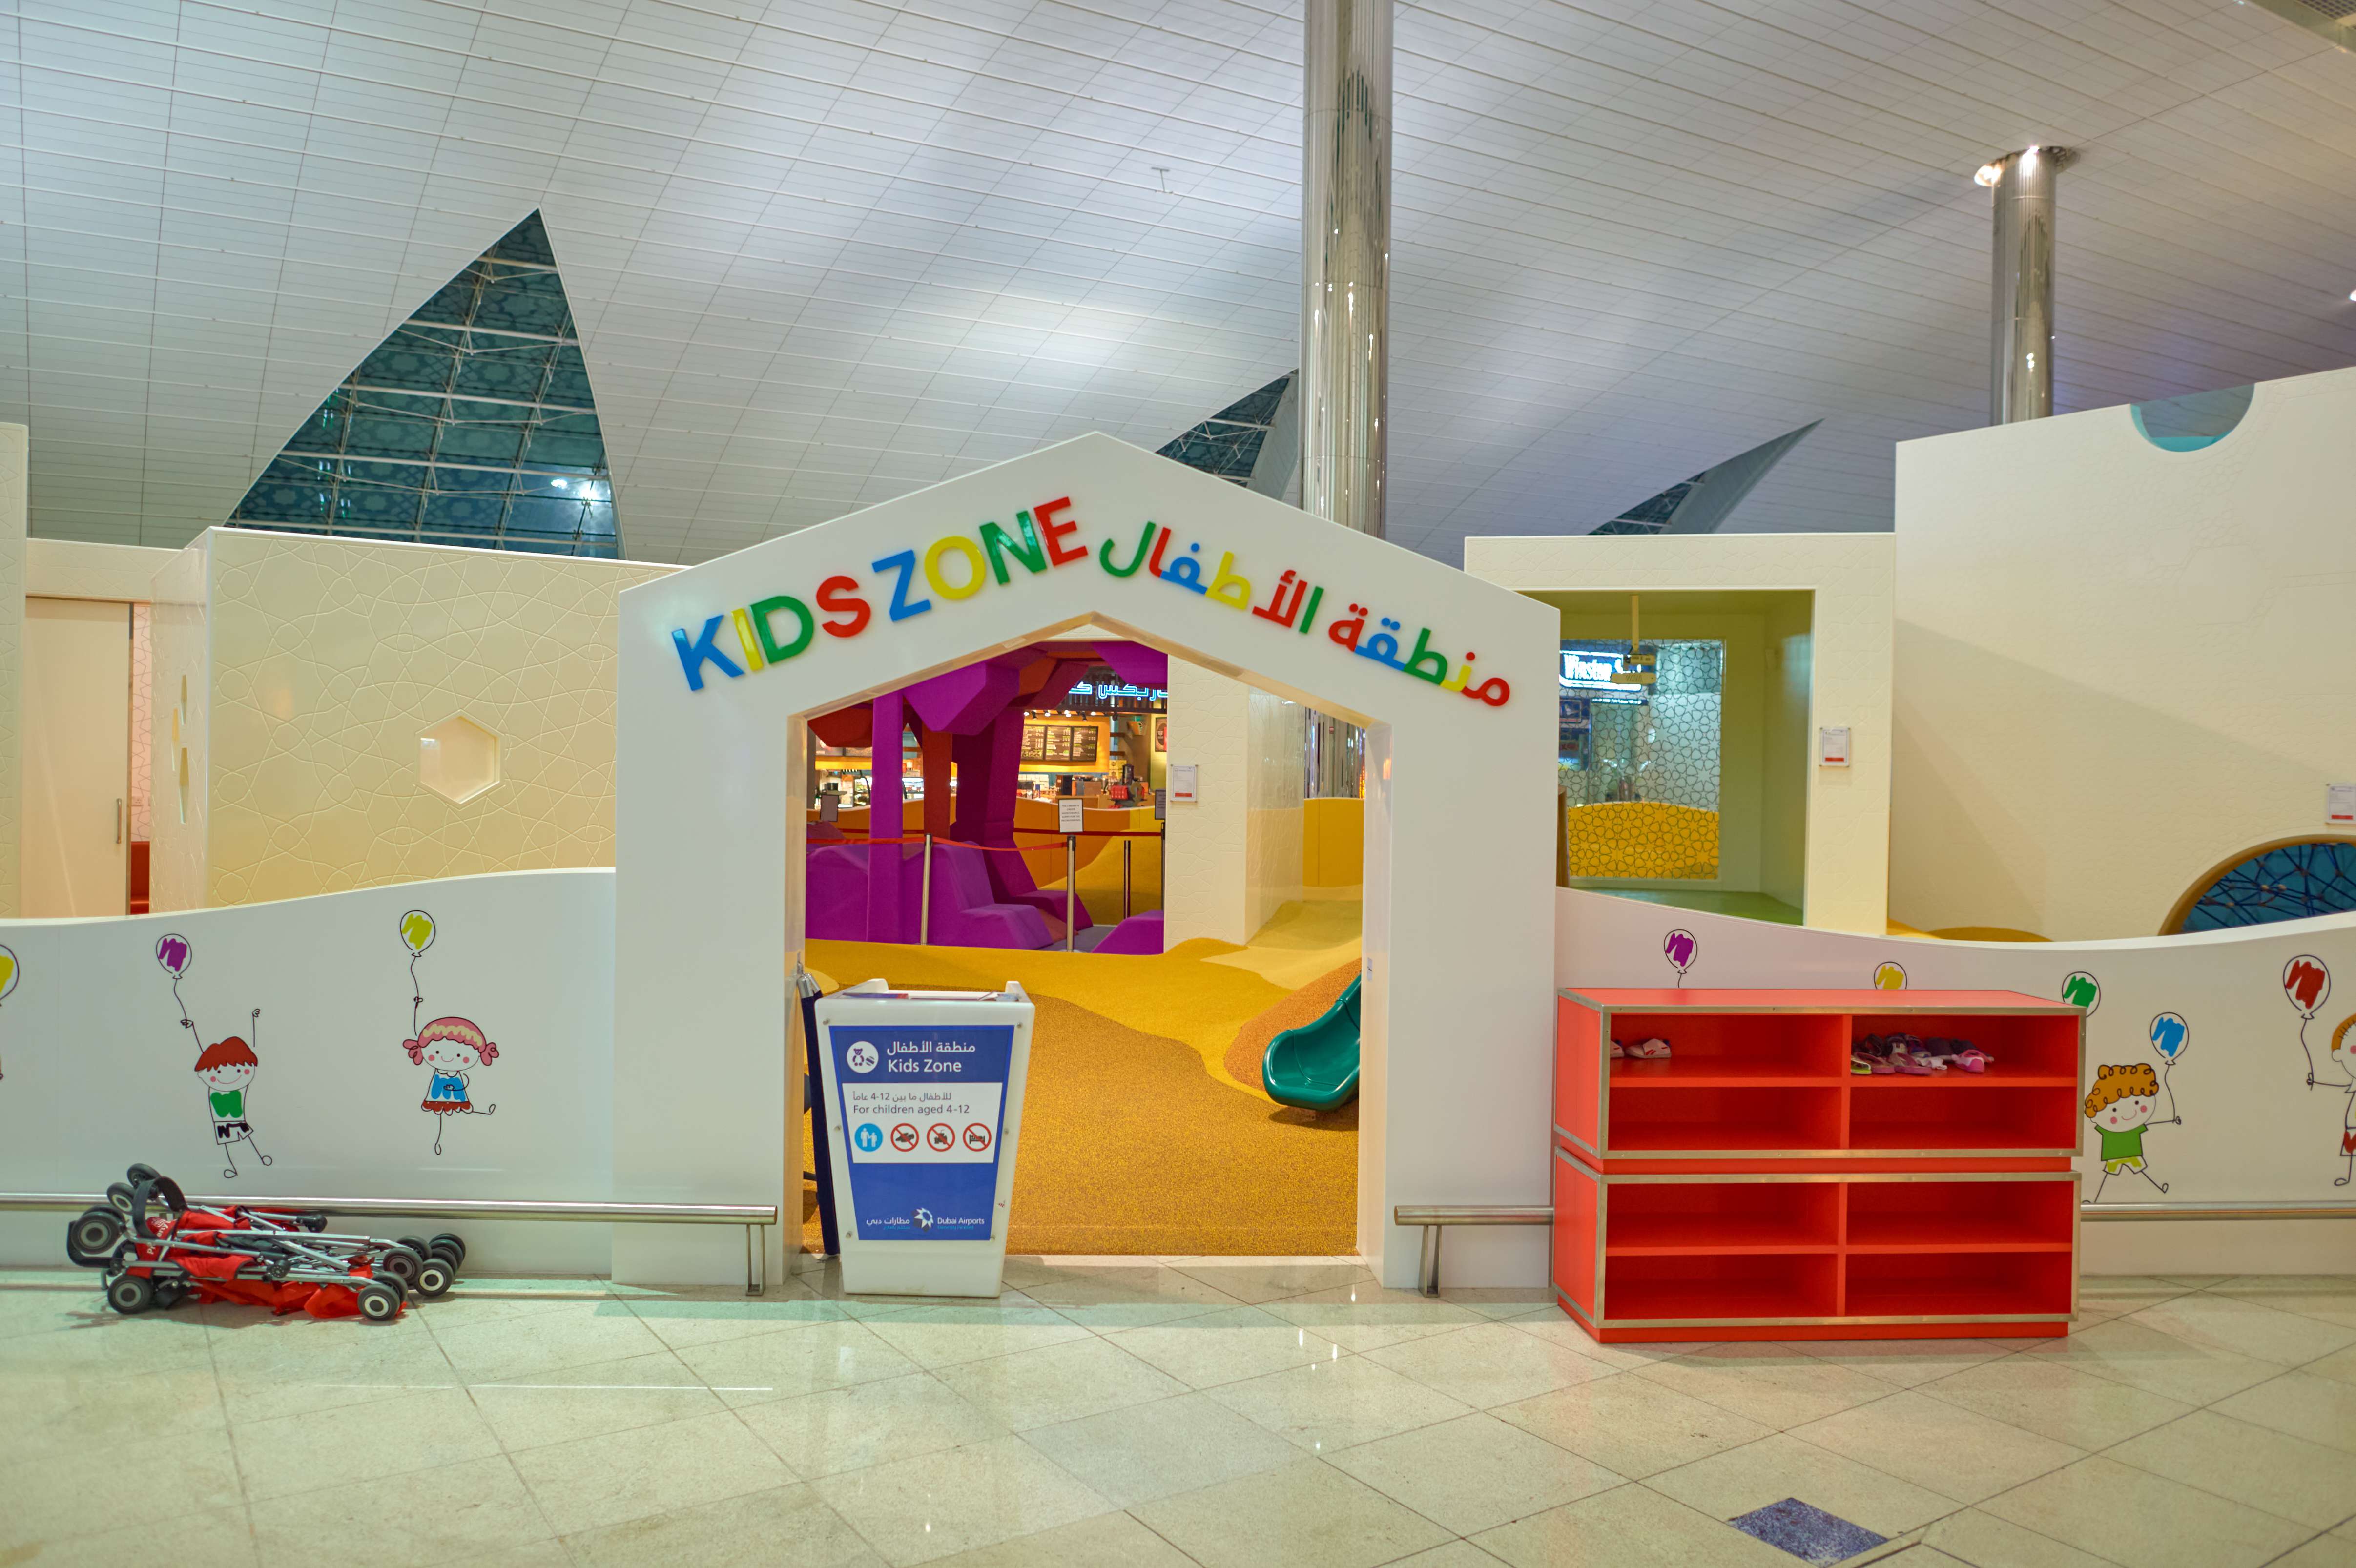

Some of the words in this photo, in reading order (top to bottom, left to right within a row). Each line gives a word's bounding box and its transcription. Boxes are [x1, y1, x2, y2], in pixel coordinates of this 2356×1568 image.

[1098, 521, 1324, 635] الأطفال
[671, 575, 871, 692] KIDS
[871, 496, 1089, 622] ZONE
[1328, 602, 1510, 707] منطقة
[887, 1040, 932, 1056] الأطفال
[936, 1041, 976, 1053] منطقة
[888, 1058, 919, 1073] Kids
[924, 1059, 962, 1073] Zone
[870, 1093, 890, 1101] 4-12
[892, 1093, 906, 1102] بين
[909, 1093, 917, 1101] ما
[919, 1092, 951, 1102] للأطفال
[853, 1105, 870, 1114] For
[873, 1104, 914, 1114] children
[917, 1104, 943, 1115] aged
[946, 1105, 970, 1114] 4-12
[866, 1219, 882, 1227] دبي
[884, 1217, 910, 1226] مطارات
[958, 1217, 985, 1225] Airports
